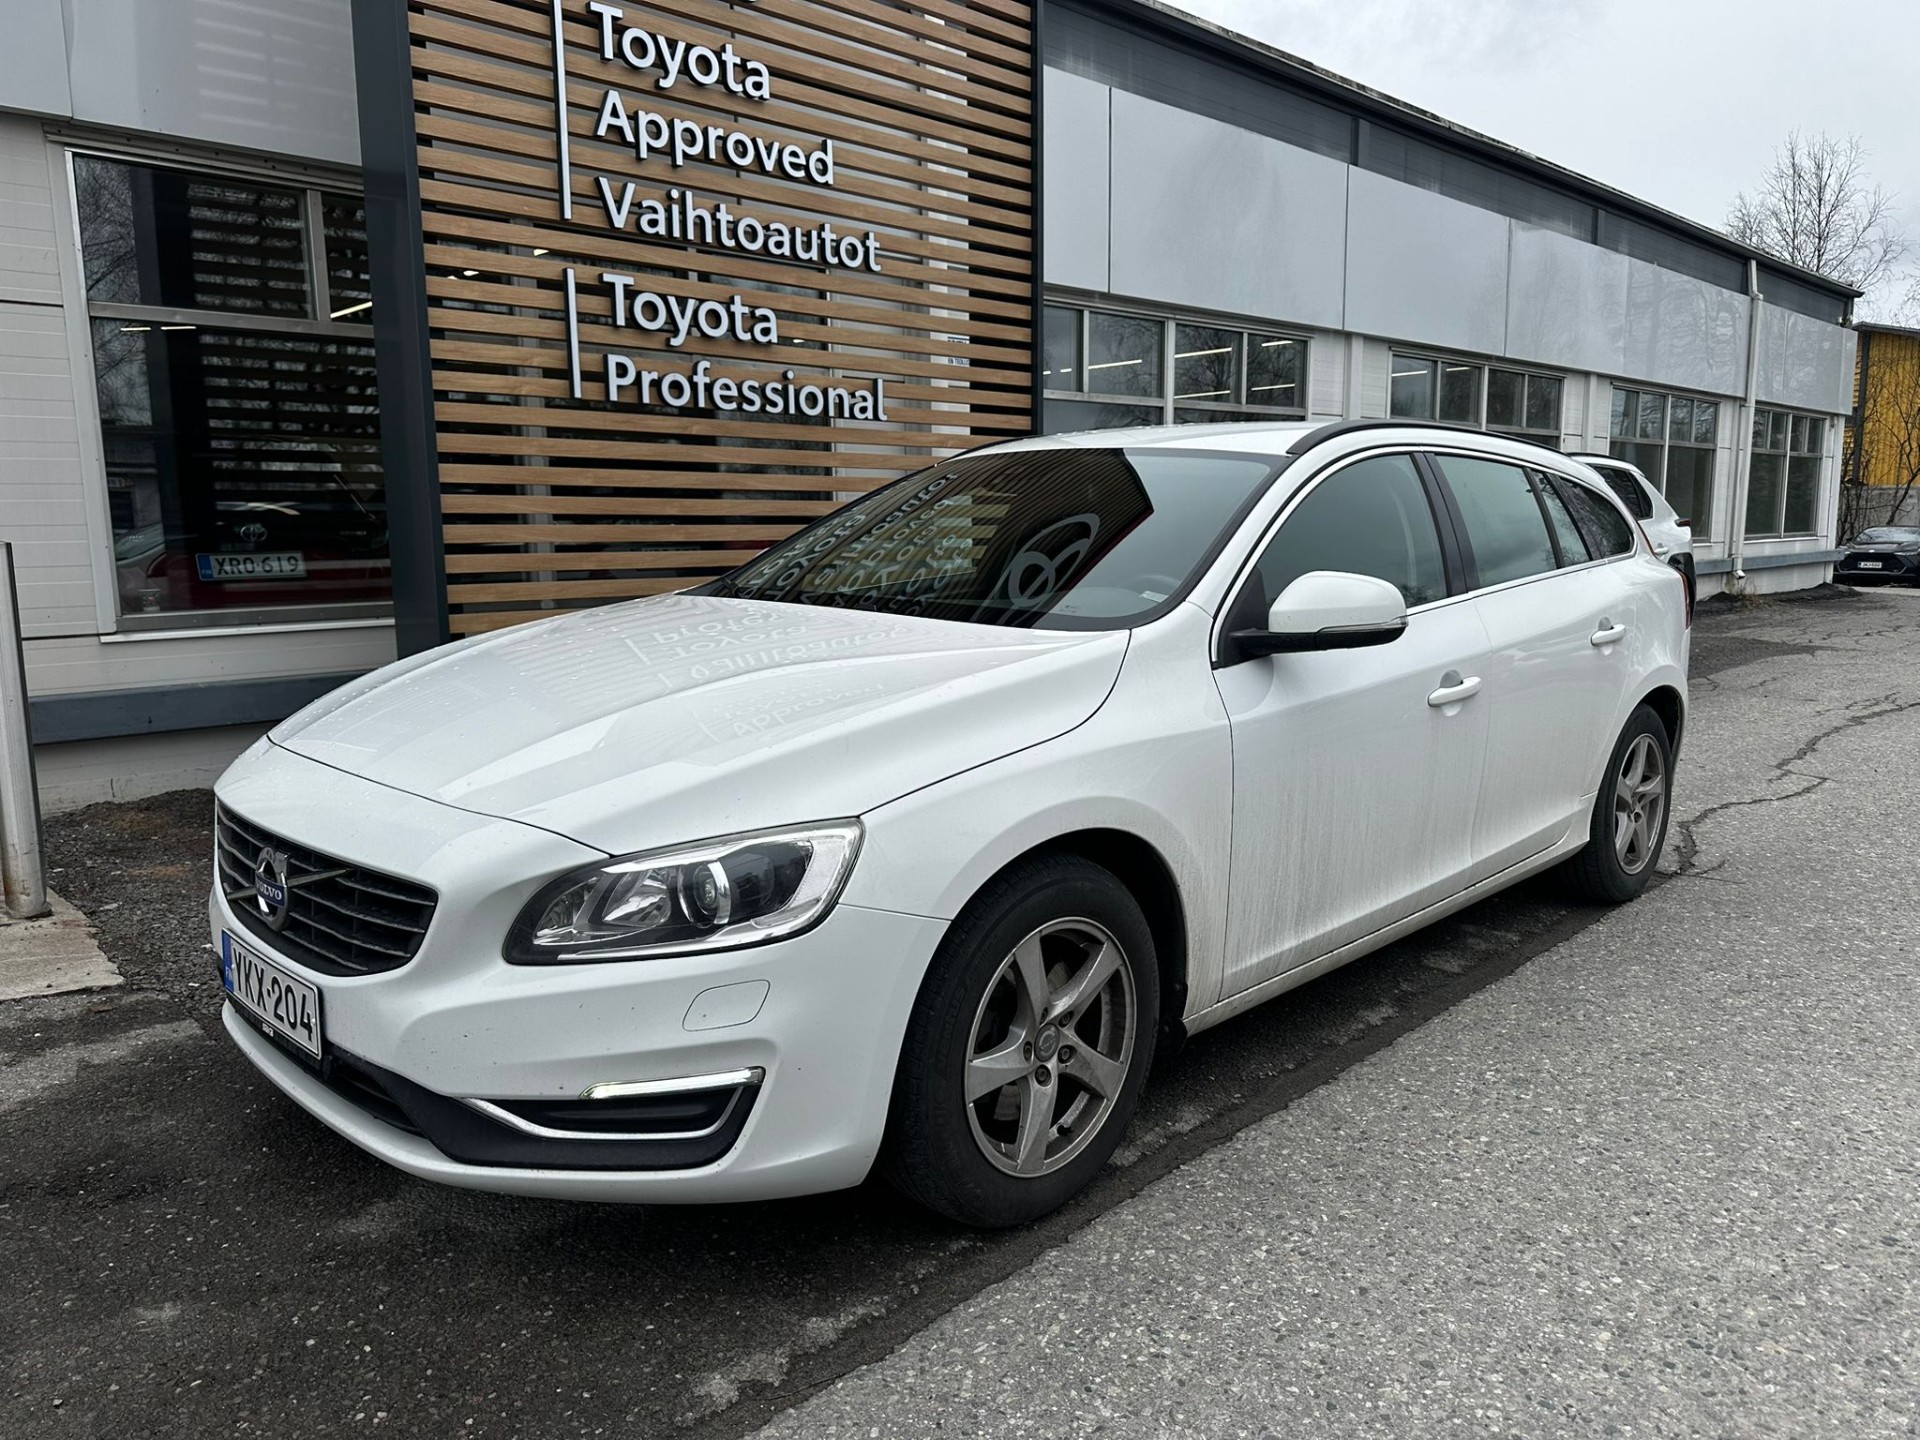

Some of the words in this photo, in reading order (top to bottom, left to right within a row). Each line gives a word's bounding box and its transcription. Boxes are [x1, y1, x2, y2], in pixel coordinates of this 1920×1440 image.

[588, 2, 771, 101] Toyota
[596, 89, 835, 186] Approved
[595, 175, 883, 272] Vaihtoautot
[601, 273, 779, 347] Toyota
[604, 353, 888, 422] Professional
[233, 947, 313, 1041] YKX-204
